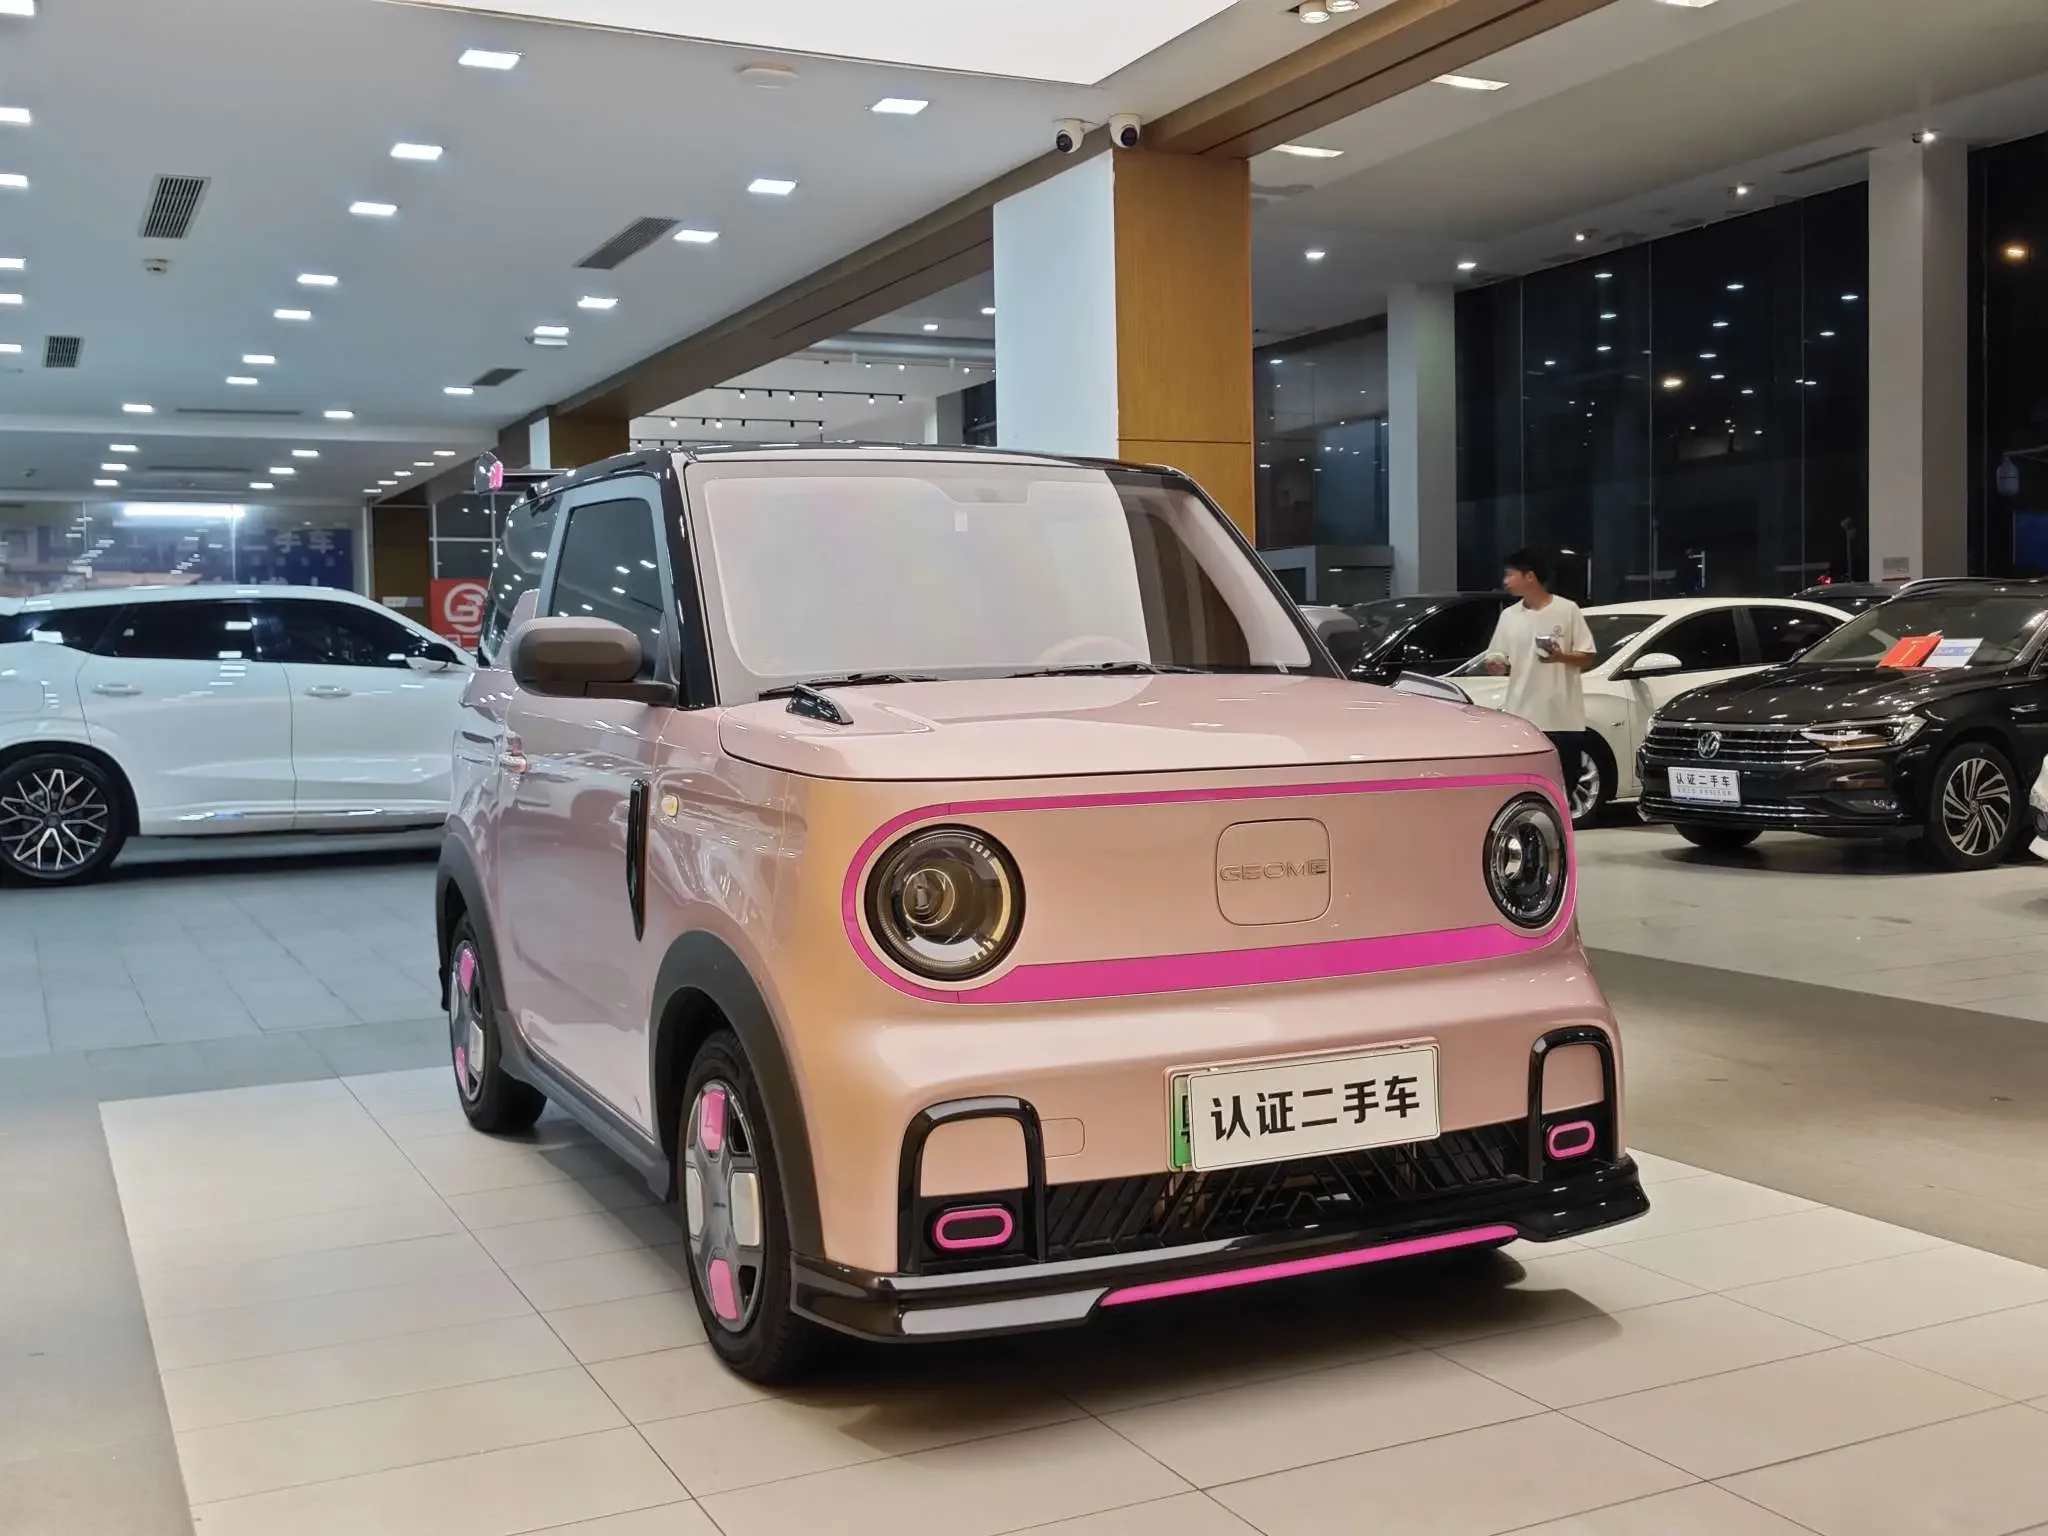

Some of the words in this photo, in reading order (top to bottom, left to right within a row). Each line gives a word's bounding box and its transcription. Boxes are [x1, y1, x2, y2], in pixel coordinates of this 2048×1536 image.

[1676, 772, 1731, 787] 认证二手车
[1219, 858, 1329, 882] GEOME
[1210, 1074, 1420, 1141] 认证二手车
